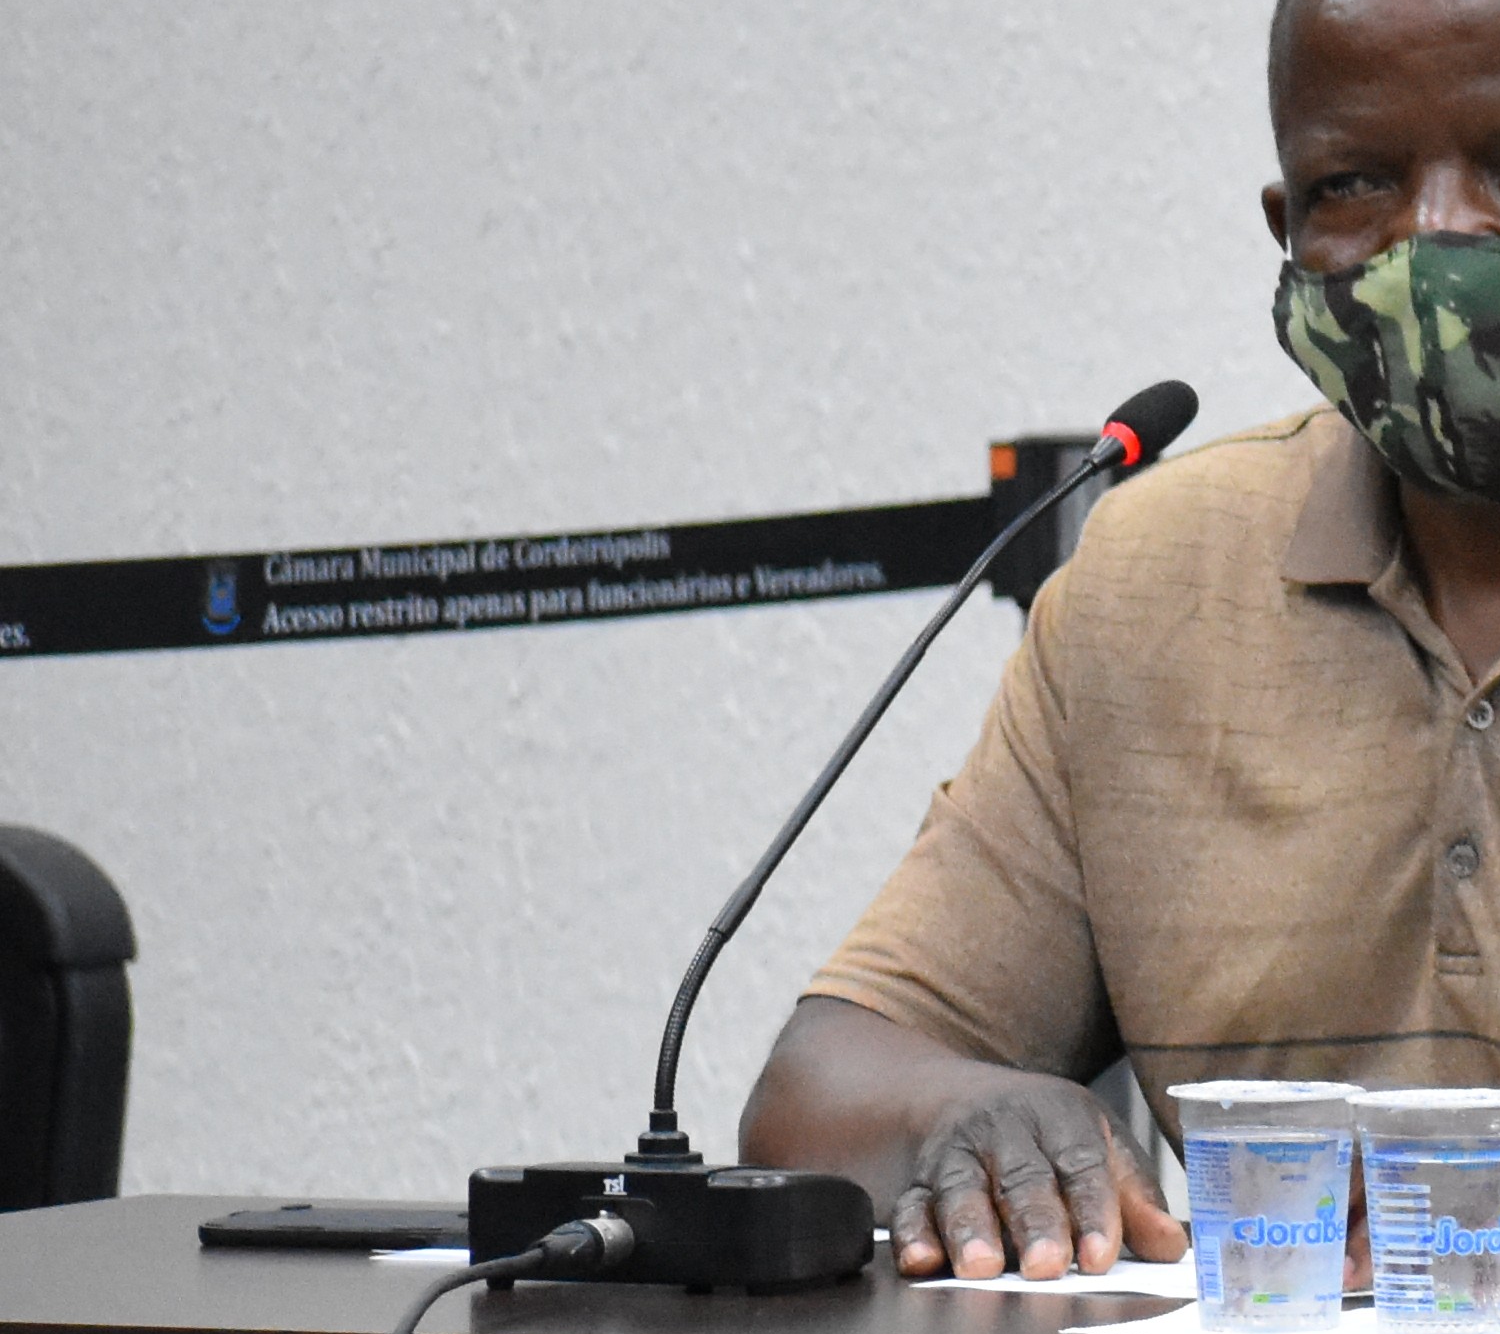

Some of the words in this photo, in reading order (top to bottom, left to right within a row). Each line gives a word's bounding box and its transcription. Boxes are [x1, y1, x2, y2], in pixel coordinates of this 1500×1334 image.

[361, 540, 475, 583] Municipal
[479, 539, 510, 570] de
[262, 601, 344, 634] Acesso
[350, 591, 439, 629] restrito
[443, 592, 526, 630] apenas
[529, 587, 584, 622] para
[735, 574, 751, 600] e
